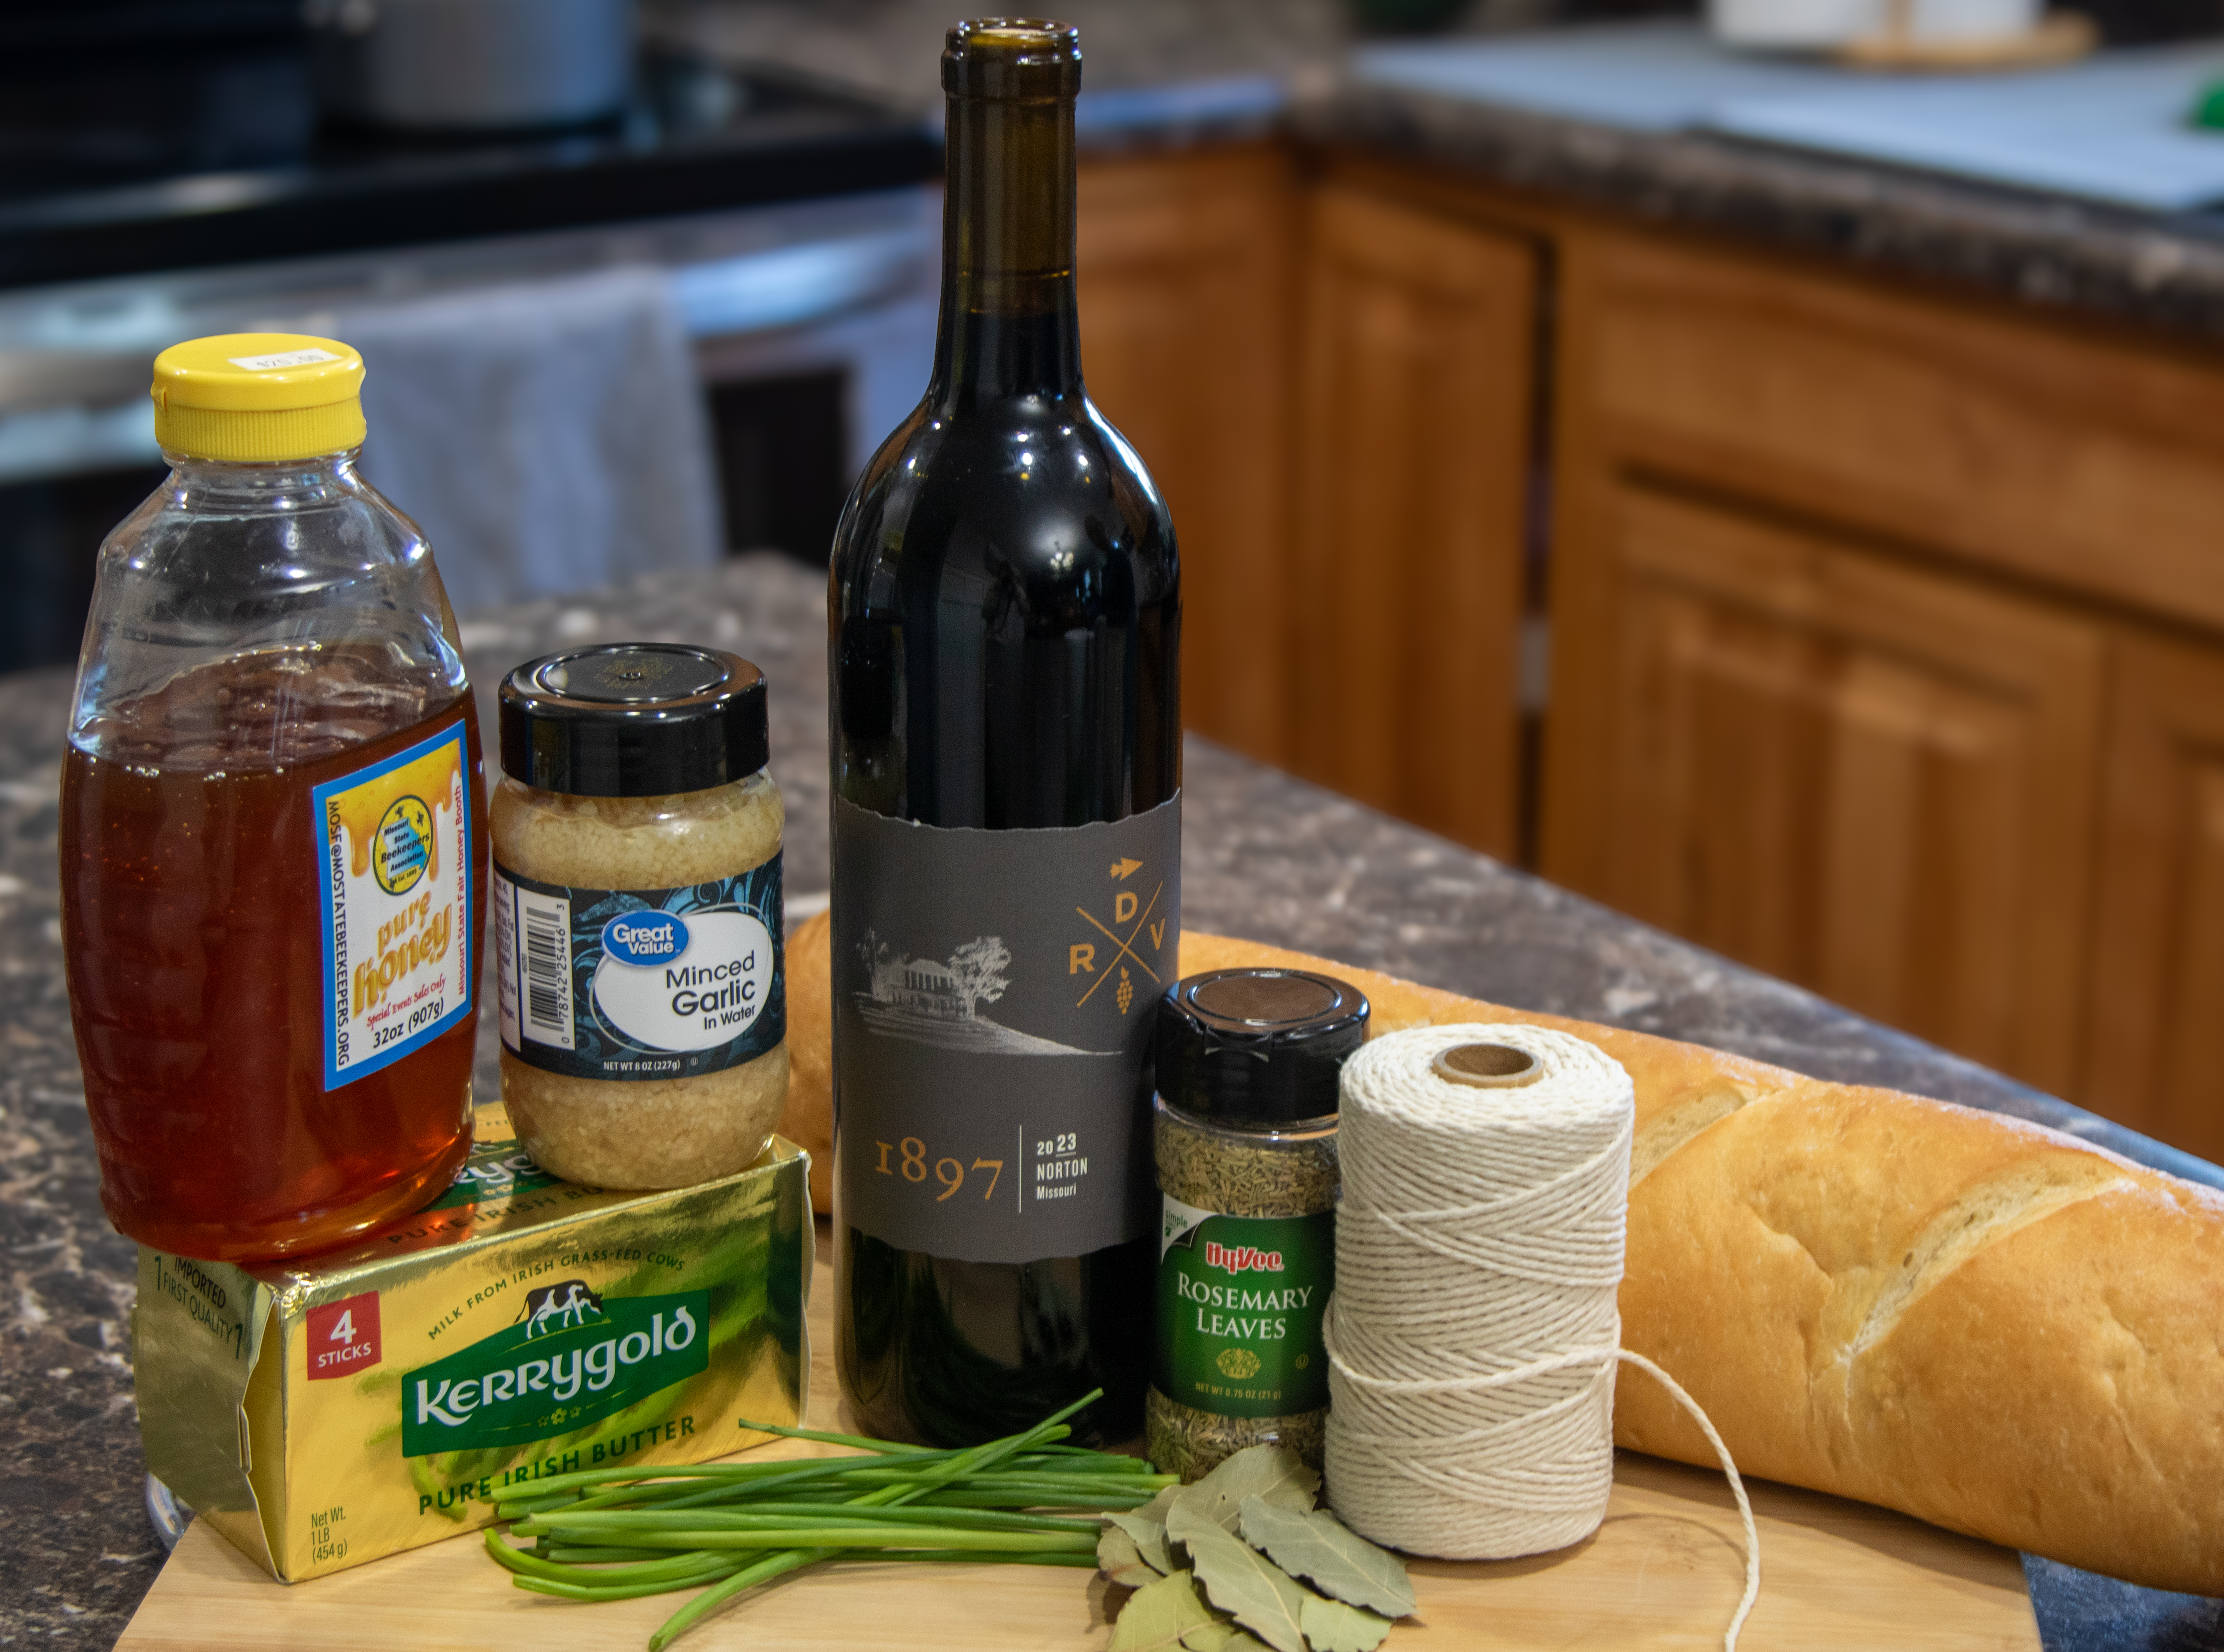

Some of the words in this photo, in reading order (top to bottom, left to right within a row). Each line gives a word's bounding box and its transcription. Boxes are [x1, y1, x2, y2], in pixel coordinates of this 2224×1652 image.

[384, 818, 409, 836] Missouri
[394, 832, 410, 844] State
[381, 833, 429, 864] Beekeepers
[391, 851, 423, 872] Association
[456, 829, 465, 872] Honey
[328, 801, 349, 1066] MOSF@MOSTATEBEEKEEPERS.ORG
[377, 891, 432, 959] pure
[613, 922, 674, 944] Great
[1070, 944, 1095, 974] R
[1115, 892, 1139, 924] D
[1150, 918, 1166, 950] V
[352, 903, 452, 1020] honey
[556, 928, 567, 970] 25446
[628, 940, 674, 956] Value
[666, 950, 755, 989] Minced
[367, 1003, 391, 1030] Special
[392, 996, 412, 1015] Events
[414, 984, 429, 1003] Sales
[431, 972, 446, 994] Only
[558, 977, 569, 1019] 78742
[672, 979, 756, 1016] Garlic
[373, 1023, 404, 1049] 32oz
[408, 996, 444, 1033] (907g)
[704, 1016, 717, 1030] In
[720, 1005, 755, 1027] Water
[604, 1061, 618, 1071] NET
[620, 1061, 633, 1071] WT
[635, 1061, 640, 1071] 8
[642, 1061, 653, 1071] OZ
[654, 1059, 680, 1072] (227g)
[875, 1136, 1003, 1202] 1897
[1037, 1157, 1088, 1182] NORTON
[475, 1197, 557, 1222] IRISH
[1037, 1183, 1077, 1200] Missouri
[175, 1255, 226, 1308] IMPORTED
[428, 1306, 463, 1340] MILK
[466, 1278, 508, 1309] FROM
[513, 1259, 554, 1284] IRISH
[560, 1248, 642, 1266] GRASS-FED
[647, 1251, 685, 1272] COWS
[1178, 1271, 1313, 1311] ROSEMARY
[164, 1271, 188, 1306] FIRST
[189, 1295, 233, 1344] QUALITY
[1197, 1308, 1286, 1339] LEAVES
[330, 1309, 357, 1345] 4
[317, 1342, 371, 1368] STICKS
[1196, 1382, 1209, 1394] NET
[1212, 1385, 1223, 1396] WT
[1245, 1389, 1256, 1400] OZ
[419, 1475, 492, 1516] PURE
[504, 1450, 579, 1487] IRISH
[592, 1416, 695, 1464] BUTTER
[311, 1510, 328, 1529] Net
[330, 1506, 346, 1523] Wt.
[311, 1530, 315, 1547] 1
[318, 1526, 330, 1545] LB
